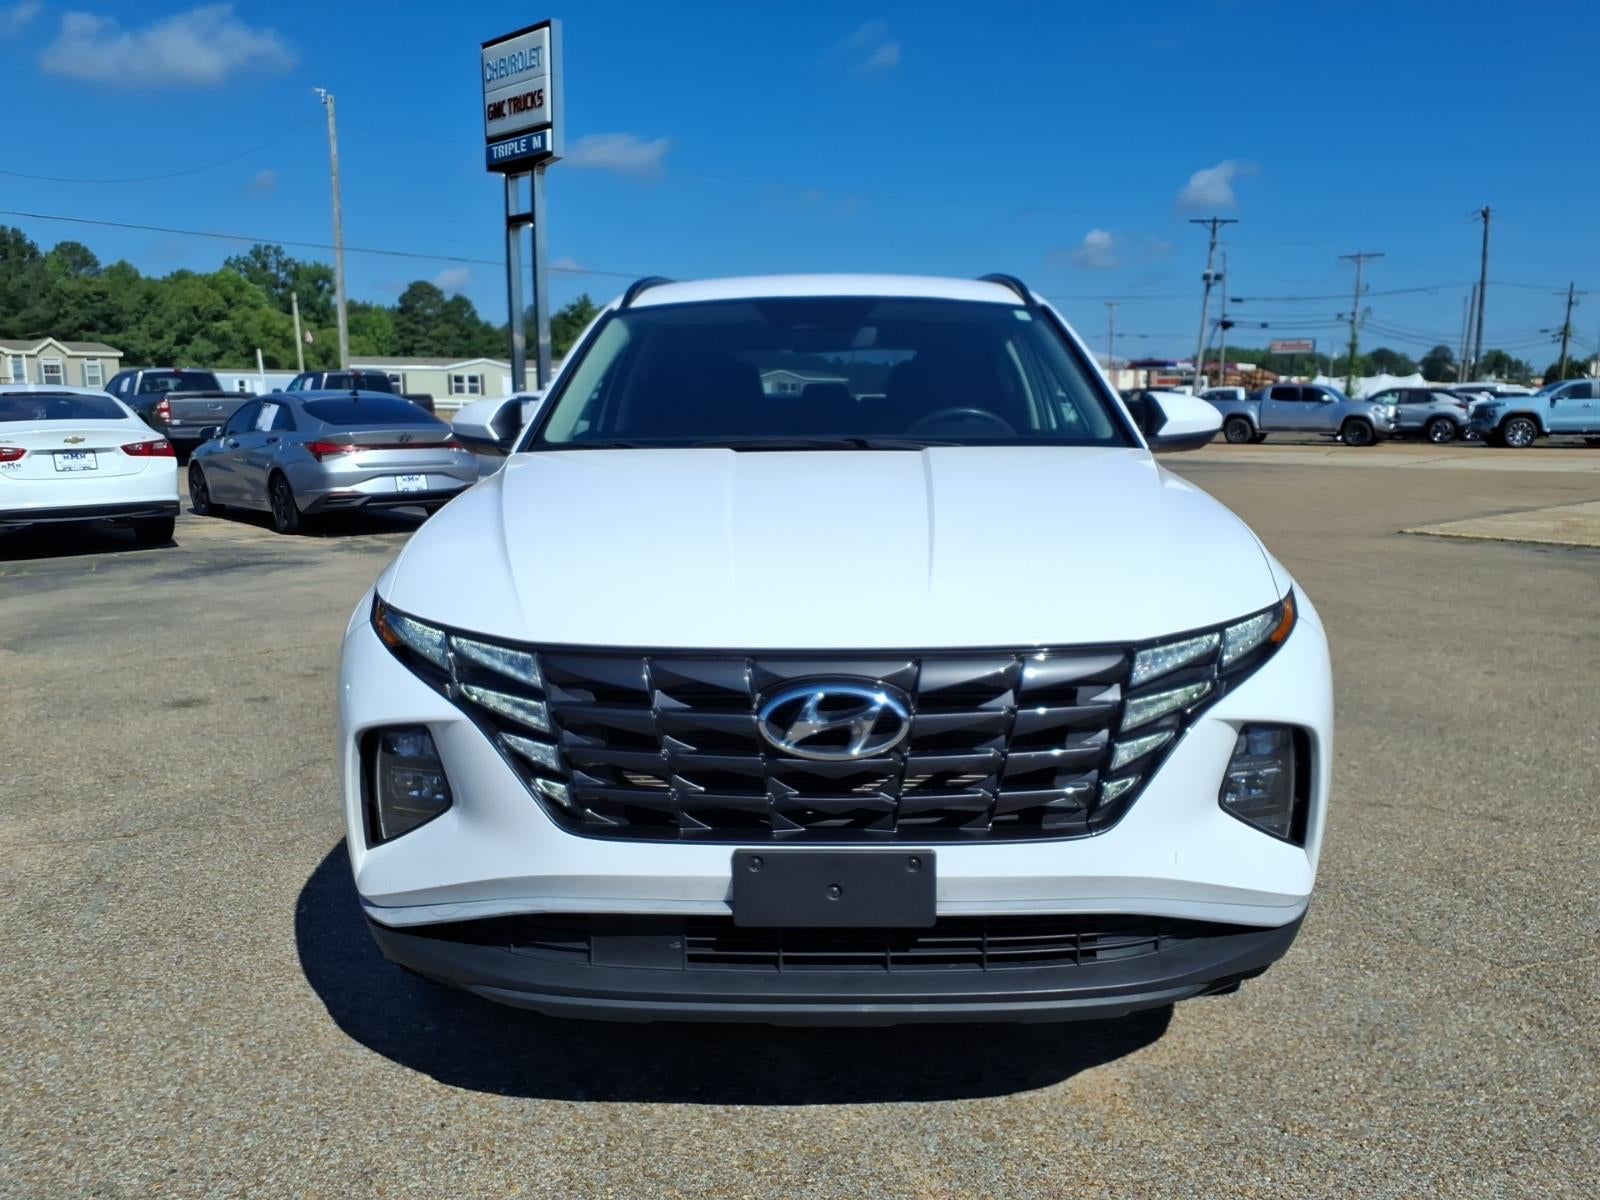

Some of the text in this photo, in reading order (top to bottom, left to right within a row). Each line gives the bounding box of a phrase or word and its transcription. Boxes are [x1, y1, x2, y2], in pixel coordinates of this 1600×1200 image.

[485, 45, 543, 82] CHEVROLET
[487, 88, 544, 121] GMC TRUCKS
[491, 135, 542, 159] TRIPLE M
